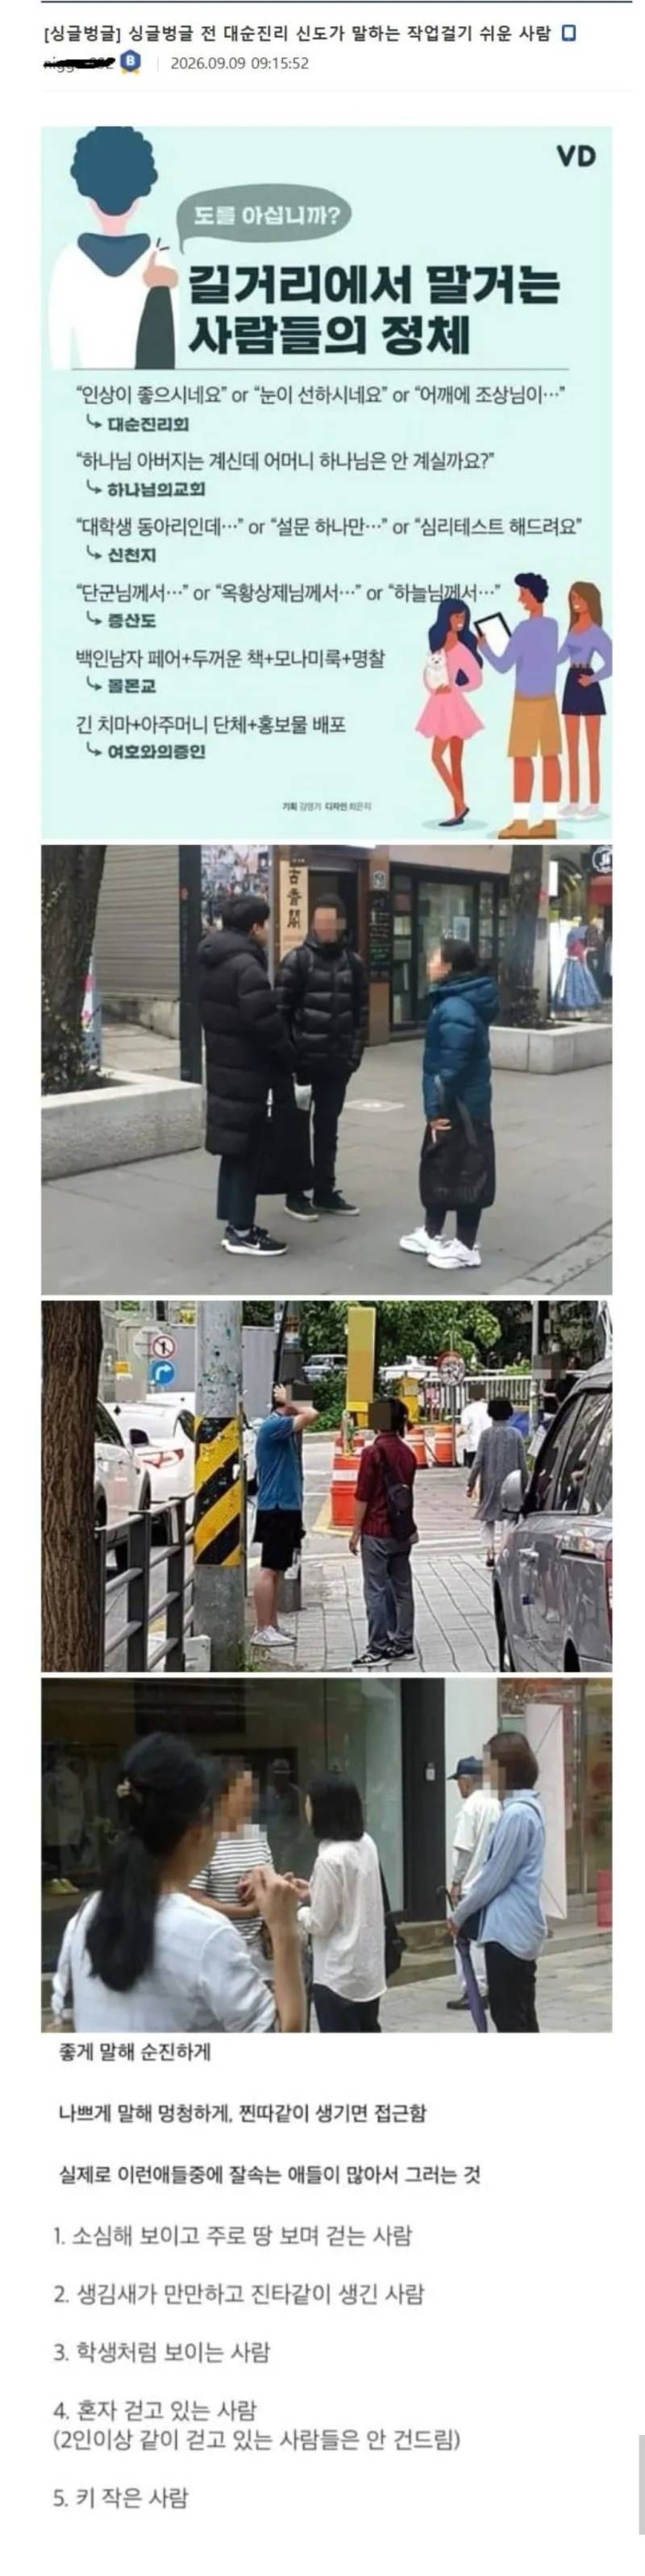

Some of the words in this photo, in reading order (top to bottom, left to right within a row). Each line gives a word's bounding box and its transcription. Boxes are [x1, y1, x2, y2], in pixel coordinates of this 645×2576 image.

[556, 145, 596, 167] VD
[194, 206, 235, 225] 도를
[242, 206, 340, 225] 아십니까?
[189, 265, 411, 305] 길거리에서
[427, 265, 560, 305] 말거는
[189, 316, 365, 356] 사람들의
[382, 316, 469, 356] 정체
[232, 390, 248, 402] or
[393, 391, 410, 402] or
[107, 417, 189, 432] 대순진리회
[137, 452, 204, 471] 아버지는
[210, 452, 258, 471] 계신데
[264, 452, 313, 471] 어머니
[319, 452, 386, 471] 하나님은
[392, 452, 408, 470] 안
[107, 481, 205, 497] 하나님의교회
[248, 522, 265, 535] or
[393, 522, 410, 535] or
[108, 547, 156, 563] 신천지
[194, 589, 210, 601] or
[367, 589, 383, 601] or
[108, 614, 156, 629] 증산도
[77, 650, 144, 668] 백인남자
[148, 650, 242, 668] 페어+두꺼운
[248, 649, 385, 668] 책+모나미룩+명찰
[108, 679, 156, 693] 몰몬교
[77, 715, 92, 735] 긴
[98, 715, 207, 735] 치마+아주머니
[214, 715, 308, 735] 단체+홍보물
[313, 715, 346, 735] 배포
[108, 744, 205, 759] 여호와의증인
[282, 802, 298, 812] 기획
